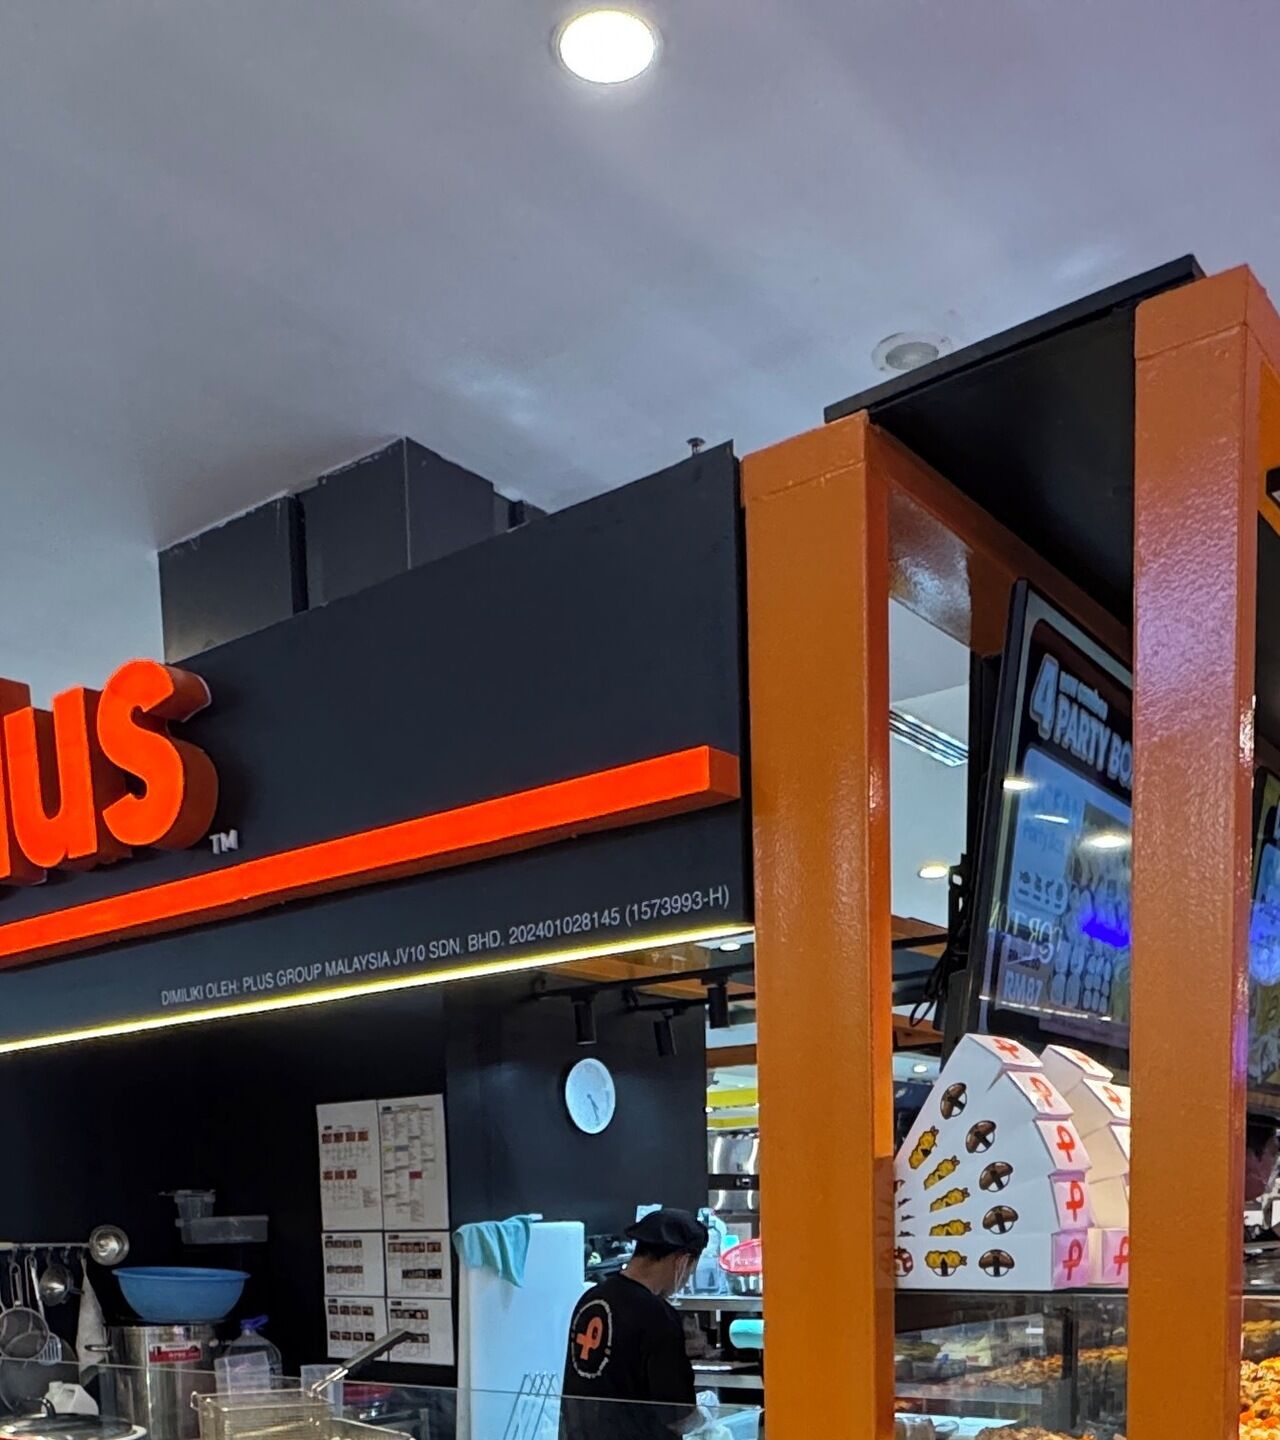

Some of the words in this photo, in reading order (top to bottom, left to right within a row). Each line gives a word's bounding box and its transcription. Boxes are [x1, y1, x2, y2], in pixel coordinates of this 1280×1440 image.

[1053, 693, 1111, 772] PARTY
[1107, 732, 1133, 791] BO
[209, 829, 239, 855] TM
[161, 985, 204, 1006] DIMILIKI
[206, 980, 240, 998] OLEH:
[243, 972, 274, 994] PLUS
[276, 963, 322, 987] GROUP
[325, 952, 391, 977] MALAYSIA
[393, 945, 425, 966] JV10
[429, 938, 460, 960] SDN.
[468, 929, 505, 952] BHD.
[509, 907, 620, 945] 202401028145
[625, 884, 729, 927] (1573993-H)
